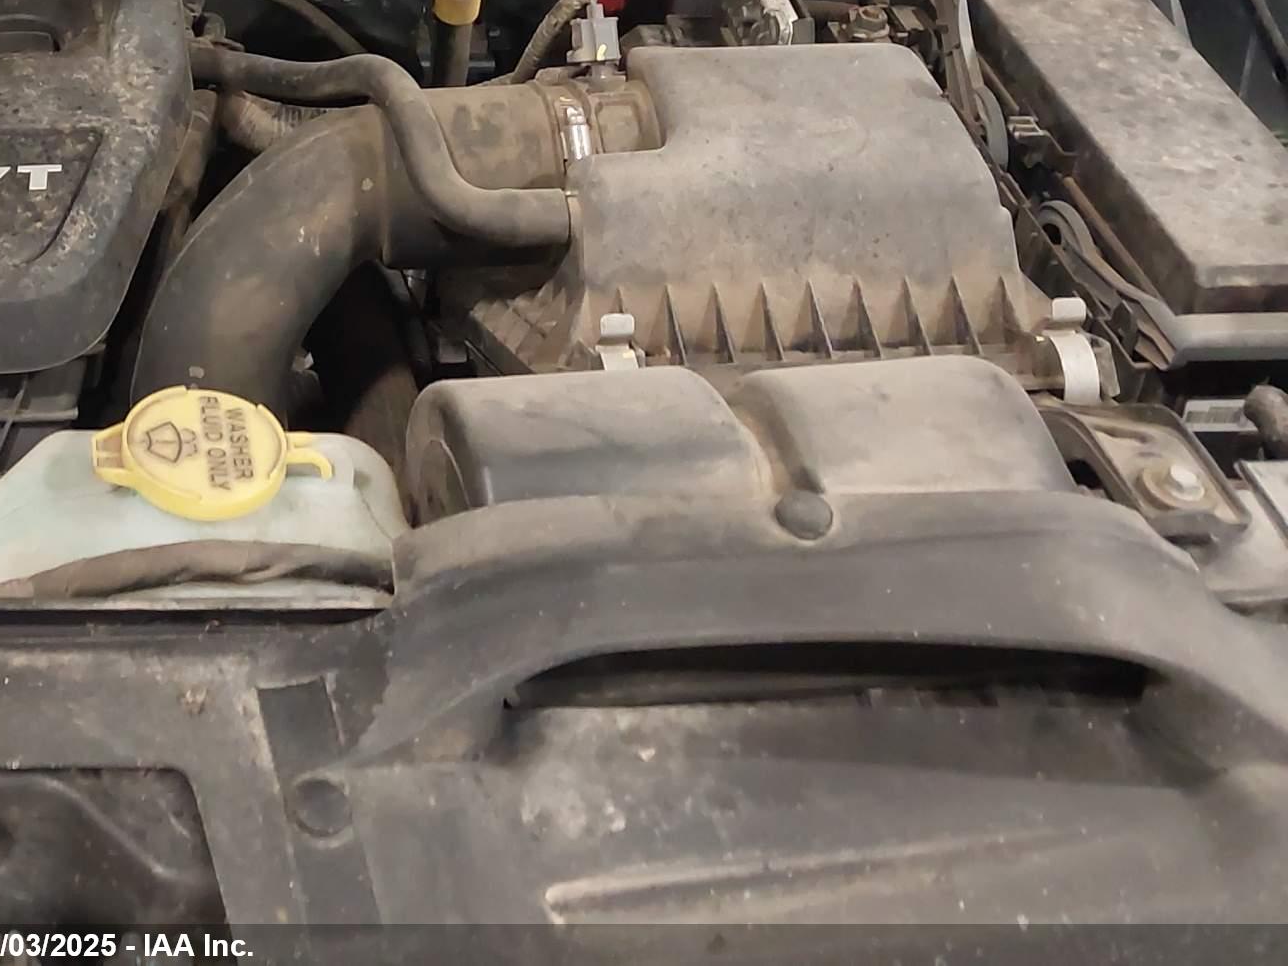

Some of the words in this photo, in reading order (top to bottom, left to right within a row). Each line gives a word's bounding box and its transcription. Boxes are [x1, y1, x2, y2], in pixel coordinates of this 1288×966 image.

[199, 396, 223, 443] FLUID
[225, 408, 254, 480] WASHER
[207, 448, 231, 490] ONLY
